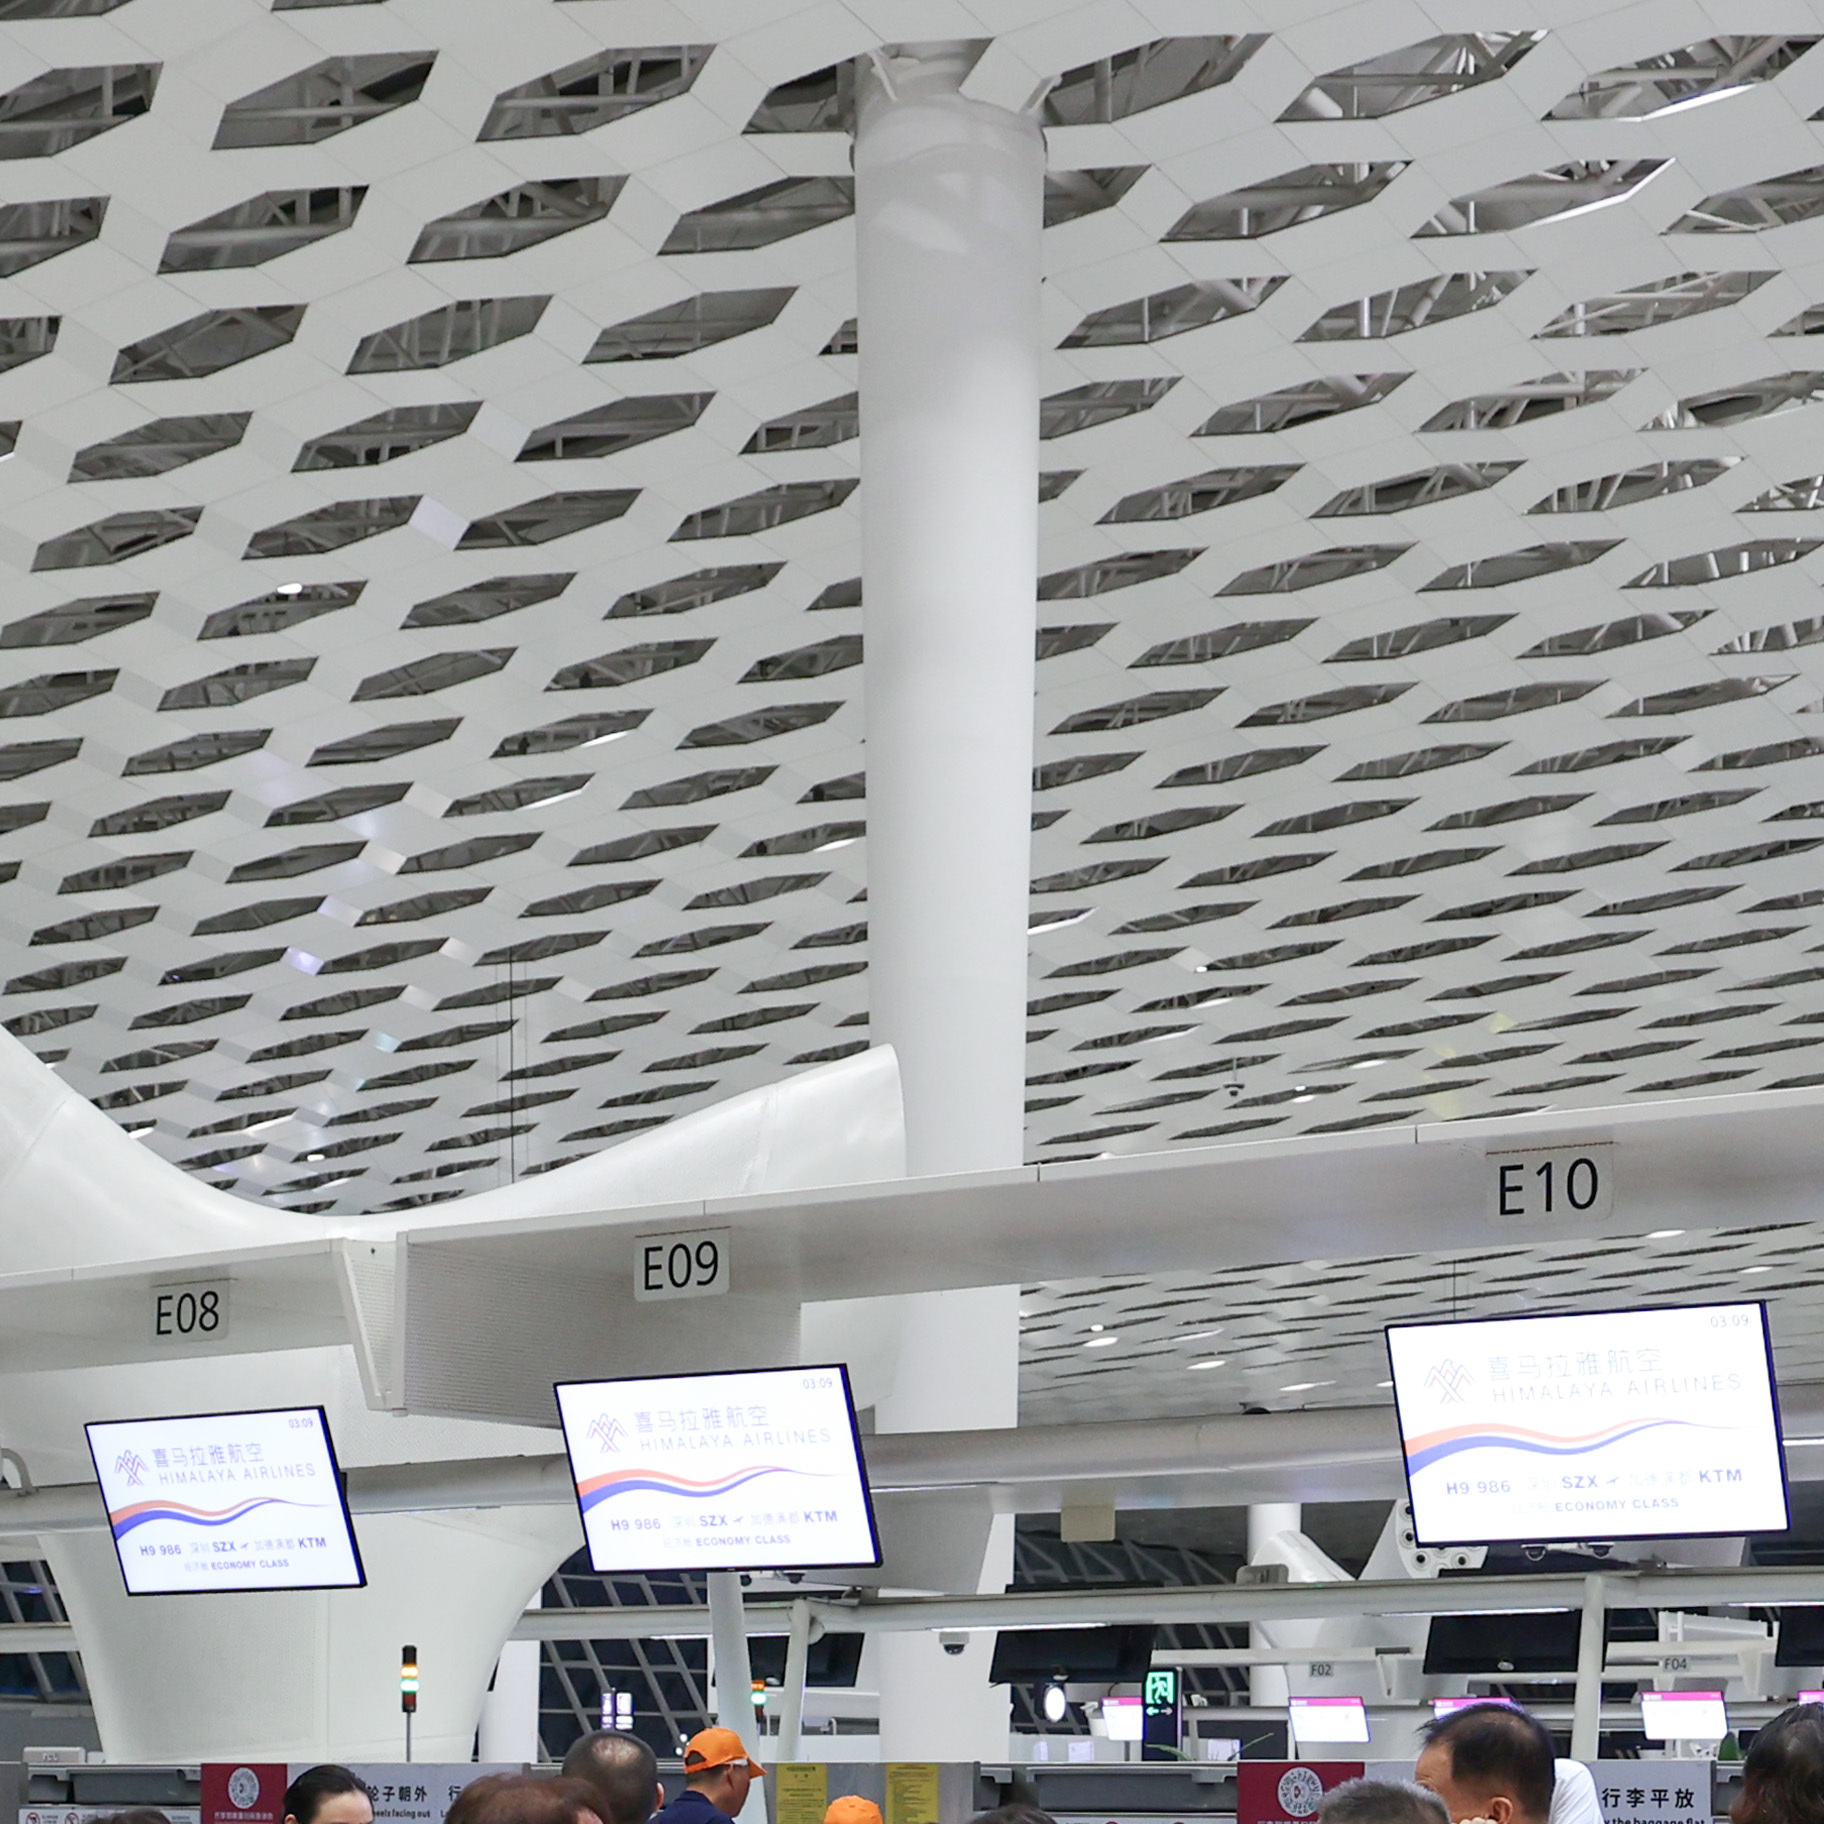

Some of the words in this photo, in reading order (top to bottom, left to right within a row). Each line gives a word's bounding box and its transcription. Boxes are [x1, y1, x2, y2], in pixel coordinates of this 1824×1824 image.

[1498, 1157, 1599, 1217] E10
[644, 1240, 718, 1290] E09
[156, 1291, 219, 1335] E08
[1710, 1314, 1749, 1328] 03:09
[1488, 1348, 1663, 1380] 喜马拉雅航空
[803, 1378, 833, 1390] 03:09
[1493, 1382, 1612, 1403] HIMALAYA
[1628, 1374, 1742, 1395] AIRLINES
[288, 1418, 314, 1428] 03:09
[634, 1405, 769, 1433] 喜马拉雅航空
[640, 1433, 733, 1452] HIMALAYA
[743, 1428, 832, 1447] AIRLINES
[152, 1443, 264, 1469] 喜马拉雅航空
[159, 1469, 236, 1486] HIMALAYA
[243, 1463, 316, 1480] AIRLINES
[1446, 1481, 1470, 1495] H9
[1477, 1479, 1511, 1493] 986
[1562, 1475, 1599, 1489] SZX
[1699, 1469, 1742, 1483] KTM
[1555, 1499, 1626, 1512] ECONOMY
[1633, 1497, 1679, 1510] CLASS
[610, 1519, 630, 1531] H9
[634, 1517, 661, 1530] 986
[699, 1514, 728, 1527] SZX
[804, 1510, 838, 1523] KTM
[140, 1545, 156, 1557] H9
[159, 1544, 182, 1556] 986
[212, 1541, 236, 1553] SZX
[298, 1537, 326, 1549] KTM
[696, 1535, 750, 1547] ECONOMY
[754, 1534, 790, 1545] CLASS
[211, 1560, 256, 1571] ECONOMY
[259, 1558, 289, 1569] CLASS
[1311, 1664, 1332, 1676] F02
[1664, 1658, 1687, 1670] F04
[367, 1785, 427, 1803] 轮子朝外
[1601, 1788, 1695, 1808] 行李平放
[392, 1808, 415, 1820] facing
